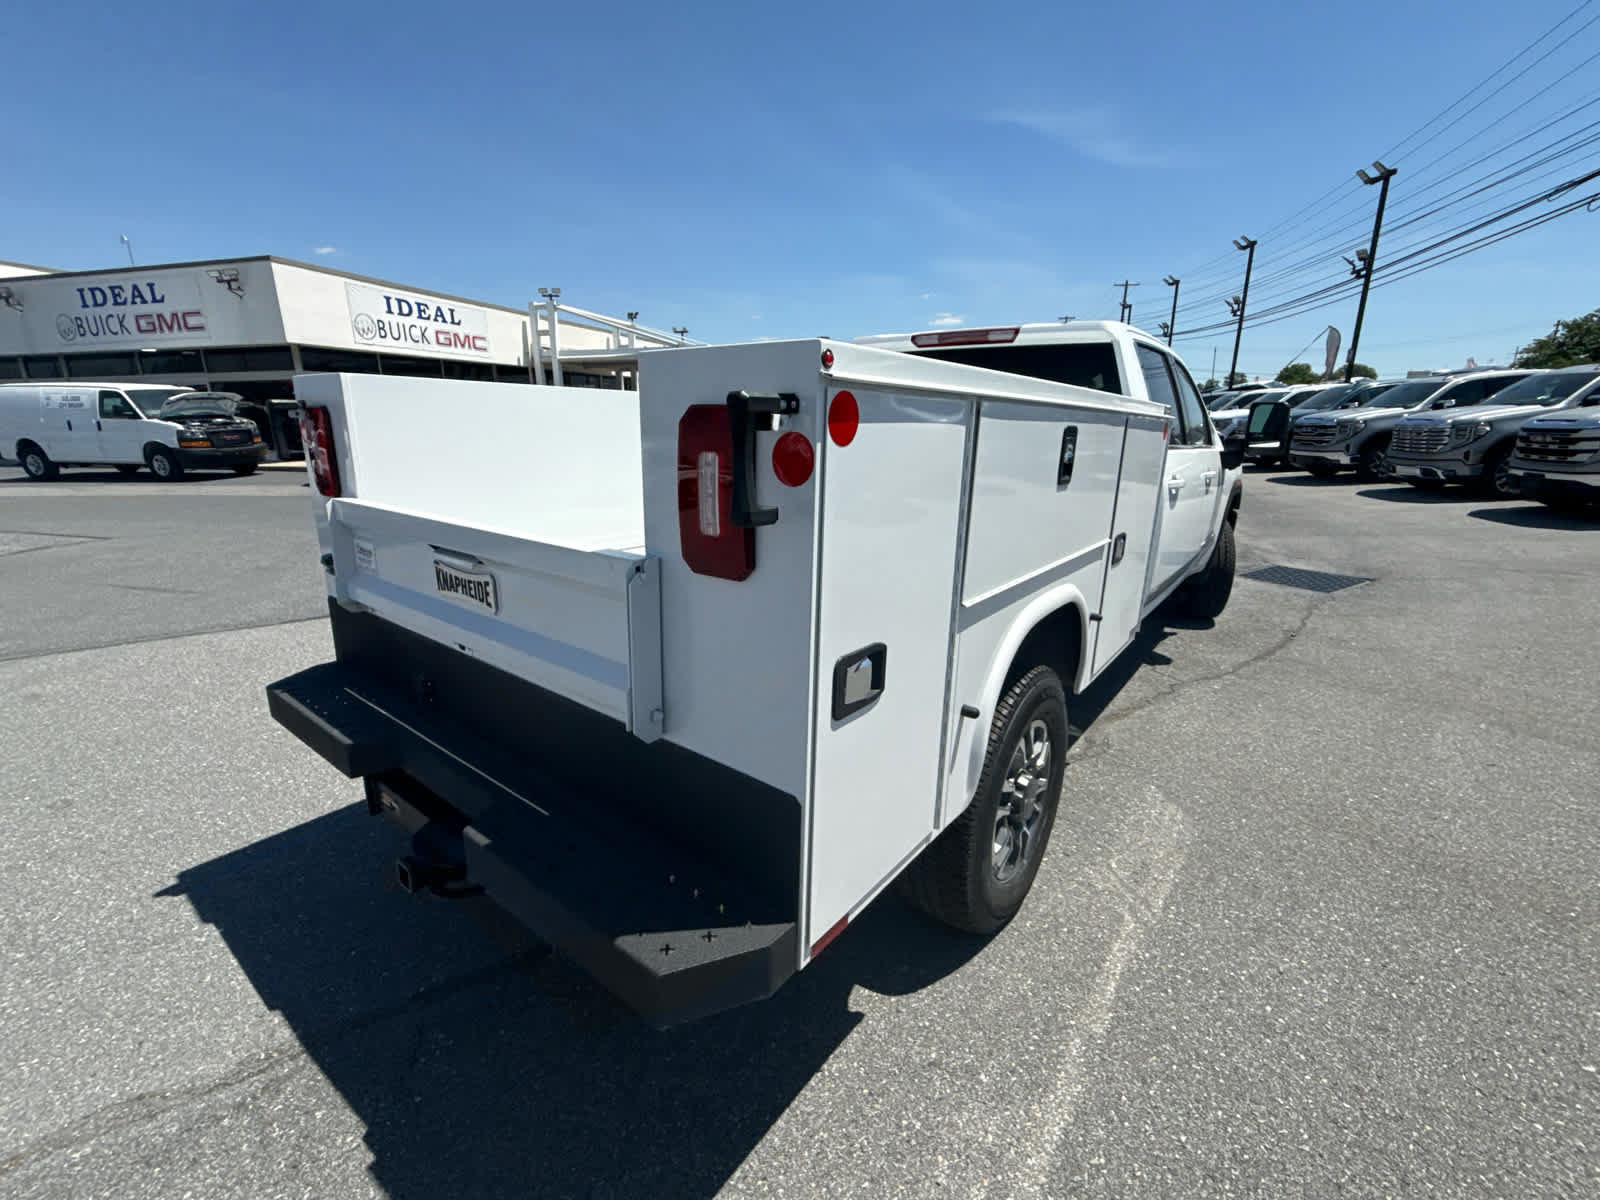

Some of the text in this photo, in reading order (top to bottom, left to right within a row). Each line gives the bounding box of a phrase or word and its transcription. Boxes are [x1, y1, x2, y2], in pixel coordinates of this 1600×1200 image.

[76, 282, 166, 309] IDEAL
[383, 295, 462, 326] IDEAL
[74, 311, 206, 338] BUICK GMC
[376, 319, 488, 351] BUICK GMC
[434, 566, 493, 609] KNAPHEIDE
